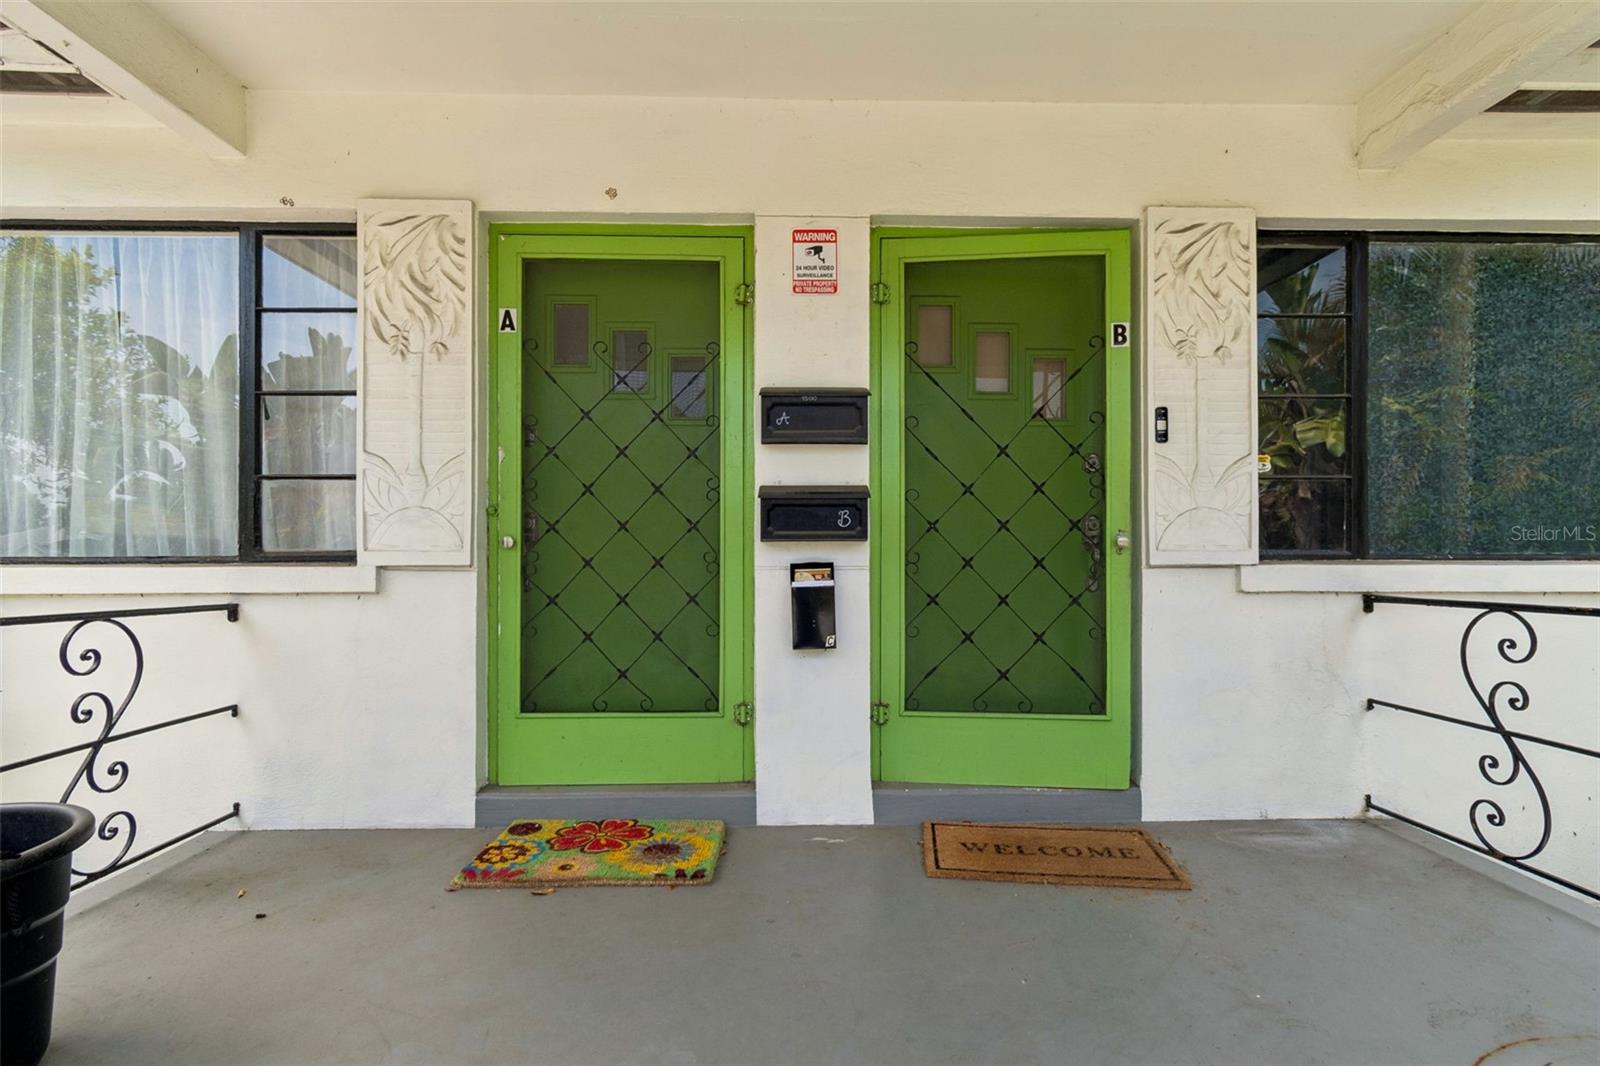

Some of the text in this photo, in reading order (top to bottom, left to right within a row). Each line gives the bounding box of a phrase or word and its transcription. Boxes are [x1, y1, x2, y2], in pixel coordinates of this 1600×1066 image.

[794, 232, 836, 241] WARNING
[500, 309, 515, 331] A
[1113, 324, 1128, 346] B
[775, 411, 791, 425] A
[837, 509, 852, 528] B
[959, 841, 1141, 859] WELCOME
